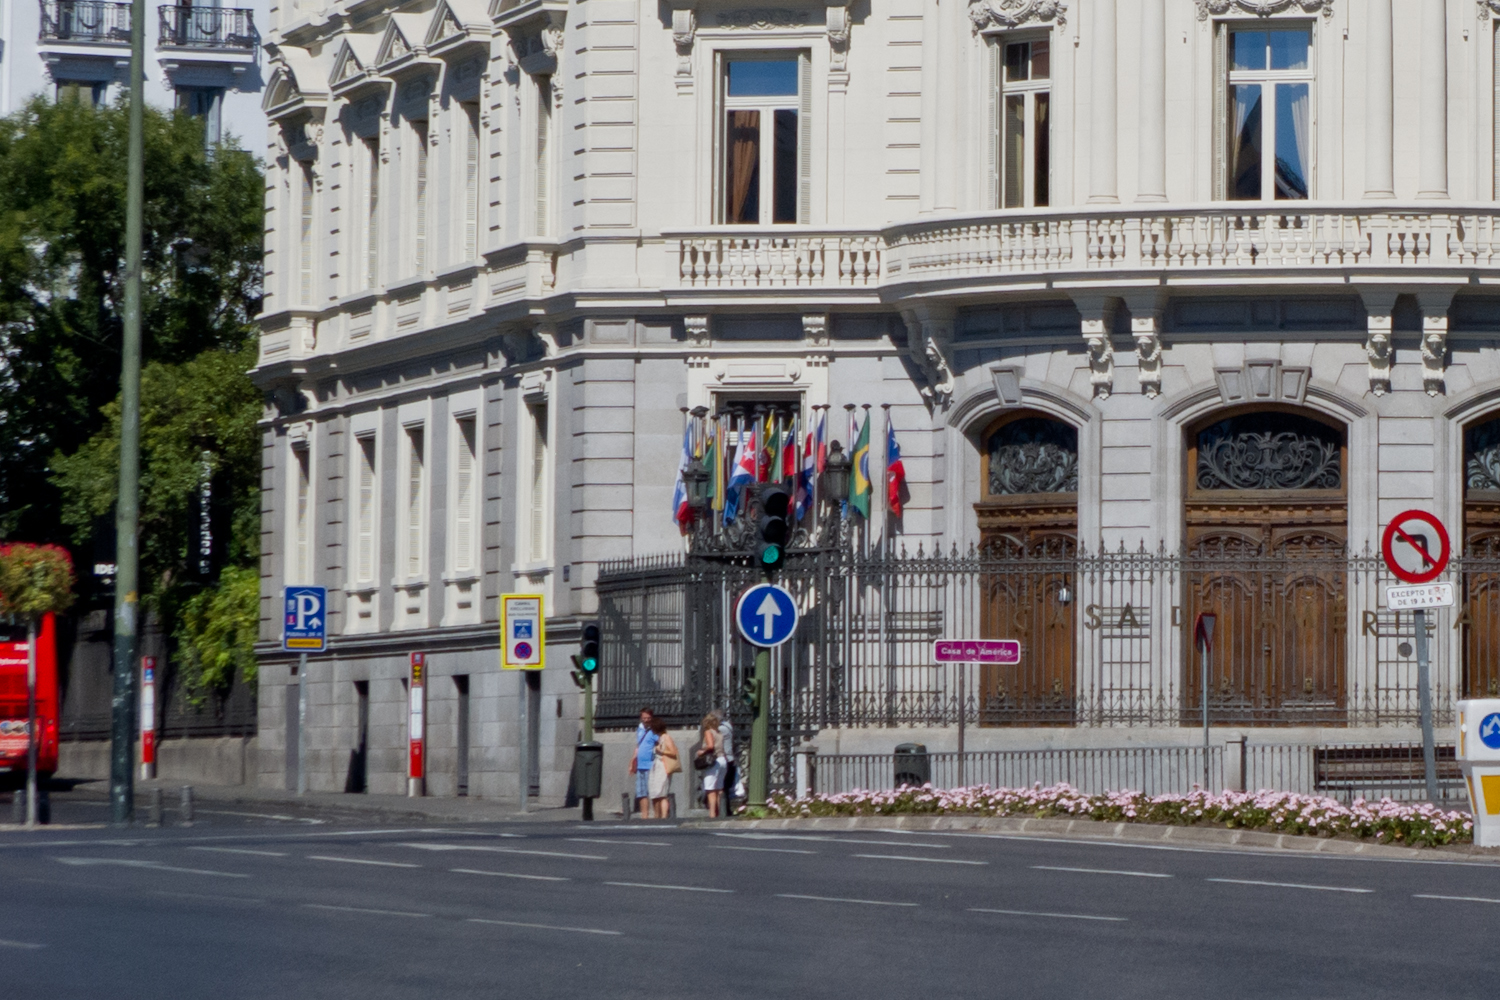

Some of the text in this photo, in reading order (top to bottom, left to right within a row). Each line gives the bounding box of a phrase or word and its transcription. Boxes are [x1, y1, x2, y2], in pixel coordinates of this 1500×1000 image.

[1391, 589, 1425, 598] EXCEPTO
[293, 595, 320, 630] P
[1013, 602, 1140, 631] CASA
[941, 647, 1012, 656] Casa de América
